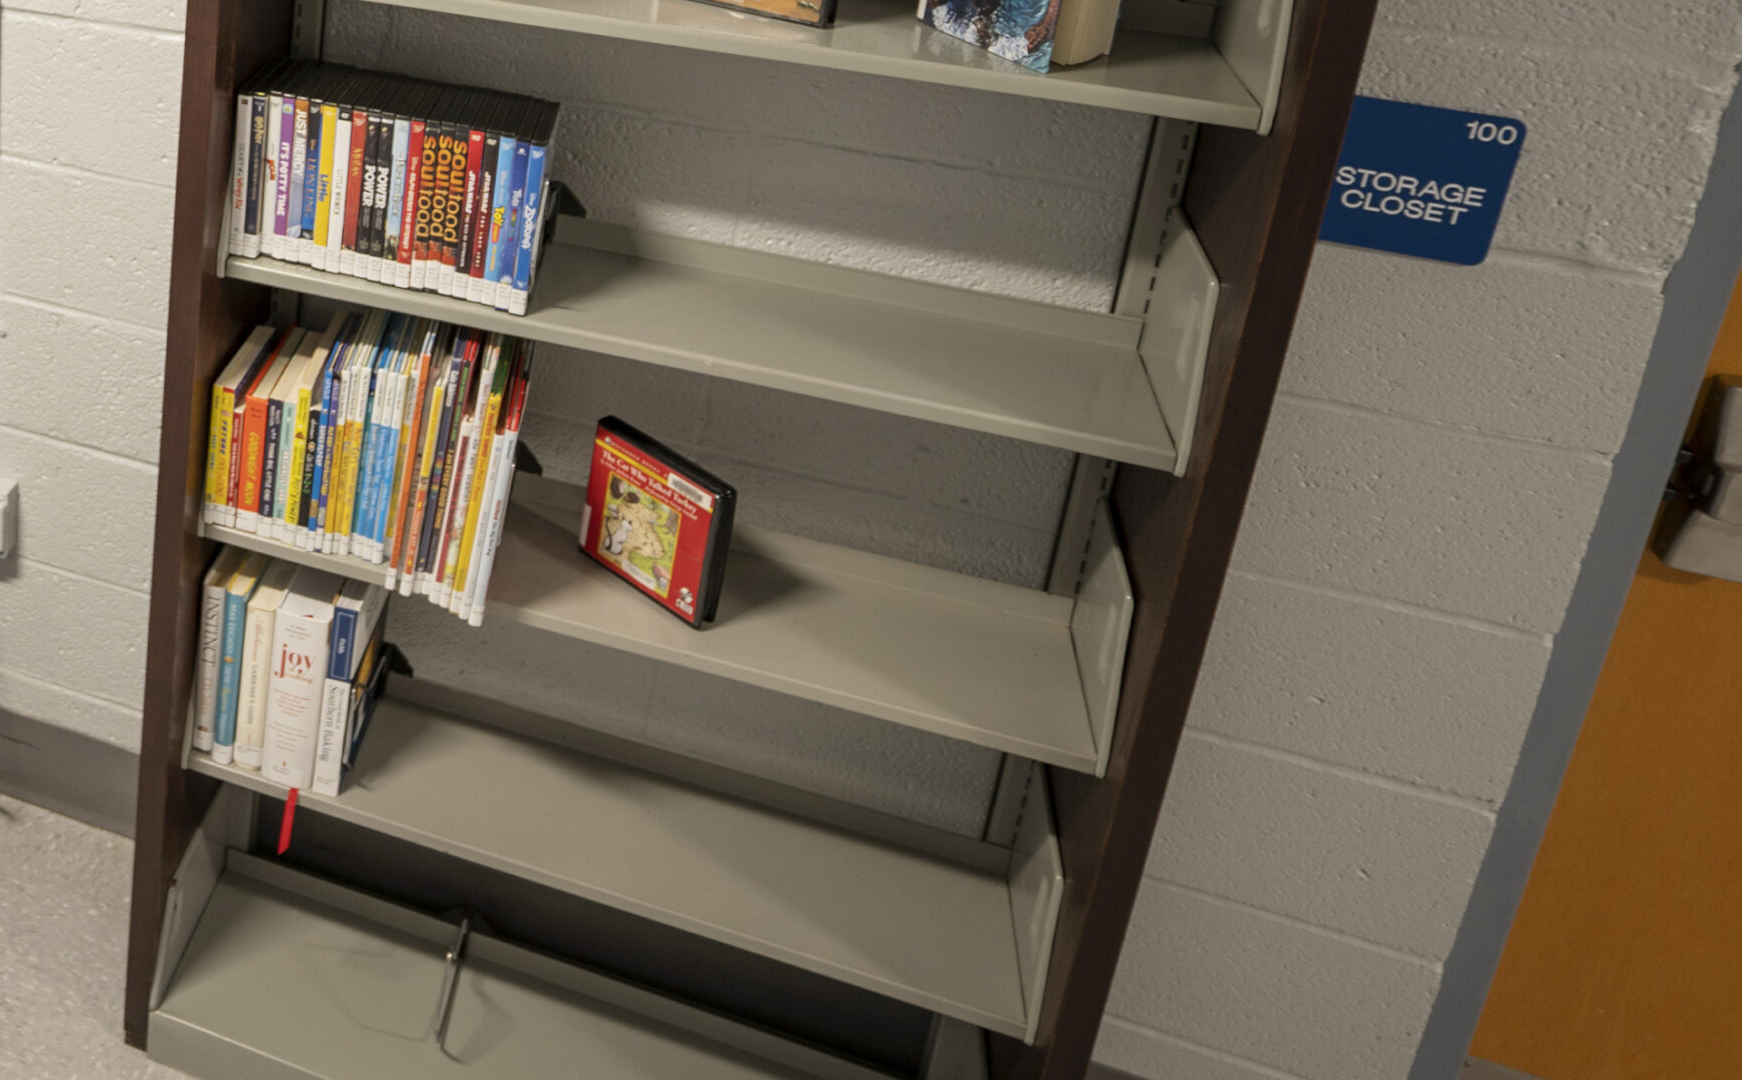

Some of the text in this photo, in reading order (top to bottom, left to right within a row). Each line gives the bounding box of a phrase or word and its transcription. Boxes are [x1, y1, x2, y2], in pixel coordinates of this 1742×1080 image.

[292, 108, 307, 178] JUST MERCY
[1465, 120, 1518, 145] 100
[276, 141, 290, 217] IT'S POTTY TIME
[317, 173, 330, 203] Little
[362, 164, 376, 207] POWER
[374, 166, 389, 210] POWER
[1335, 166, 1487, 207] STORAGE
[492, 206, 505, 227] TOY
[1341, 189, 1469, 226] CLOSET
[242, 432, 260, 506] GOODNIGHT MOON
[603, 451, 697, 515] The Cat Who Talked Turkey
[201, 595, 221, 666] INSTINCT
[274, 643, 318, 679] joy
[320, 685, 339, 763] Southern Baking
